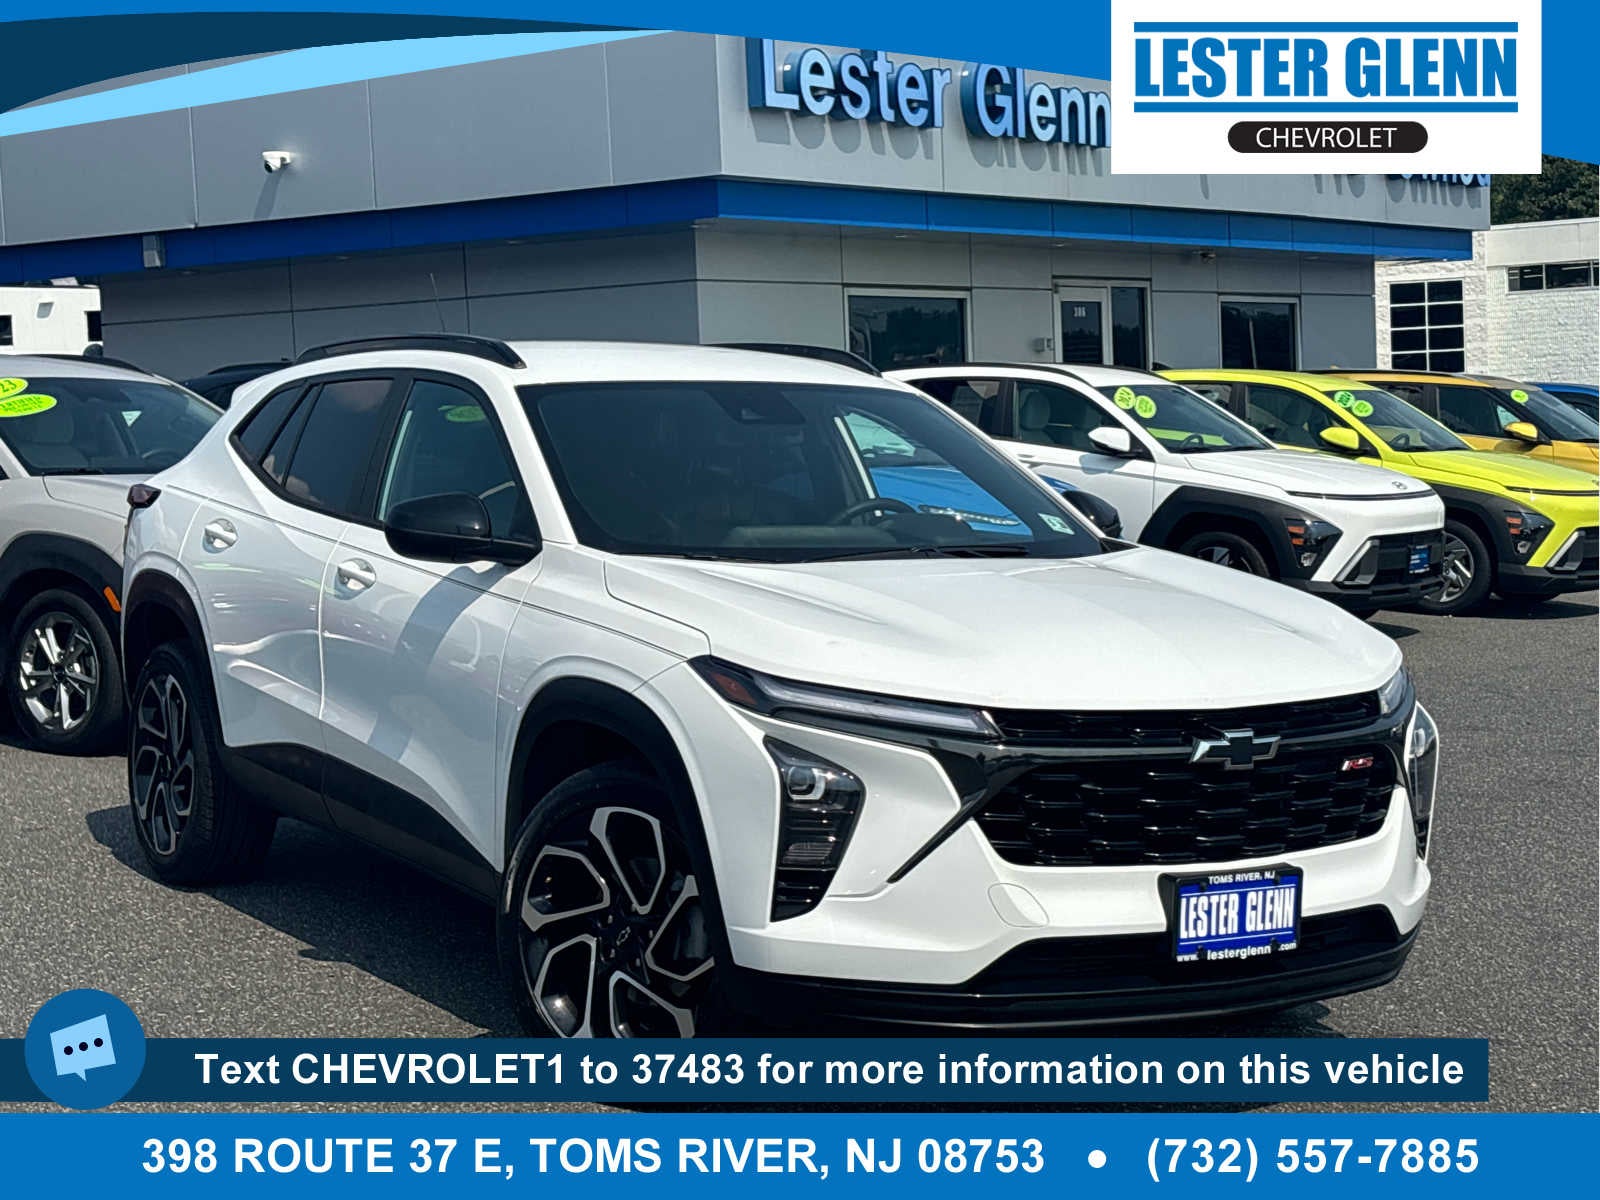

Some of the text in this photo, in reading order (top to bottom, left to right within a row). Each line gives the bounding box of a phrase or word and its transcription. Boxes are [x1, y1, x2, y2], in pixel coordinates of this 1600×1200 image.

[750, 38, 1111, 148] Lester Glenn
[1208, 874, 1233, 885] TOMS
[1264, 870, 1276, 880] NJ
[1180, 887, 1295, 939] LESTER GLENN
[1206, 945, 1272, 961] lesterglenn
